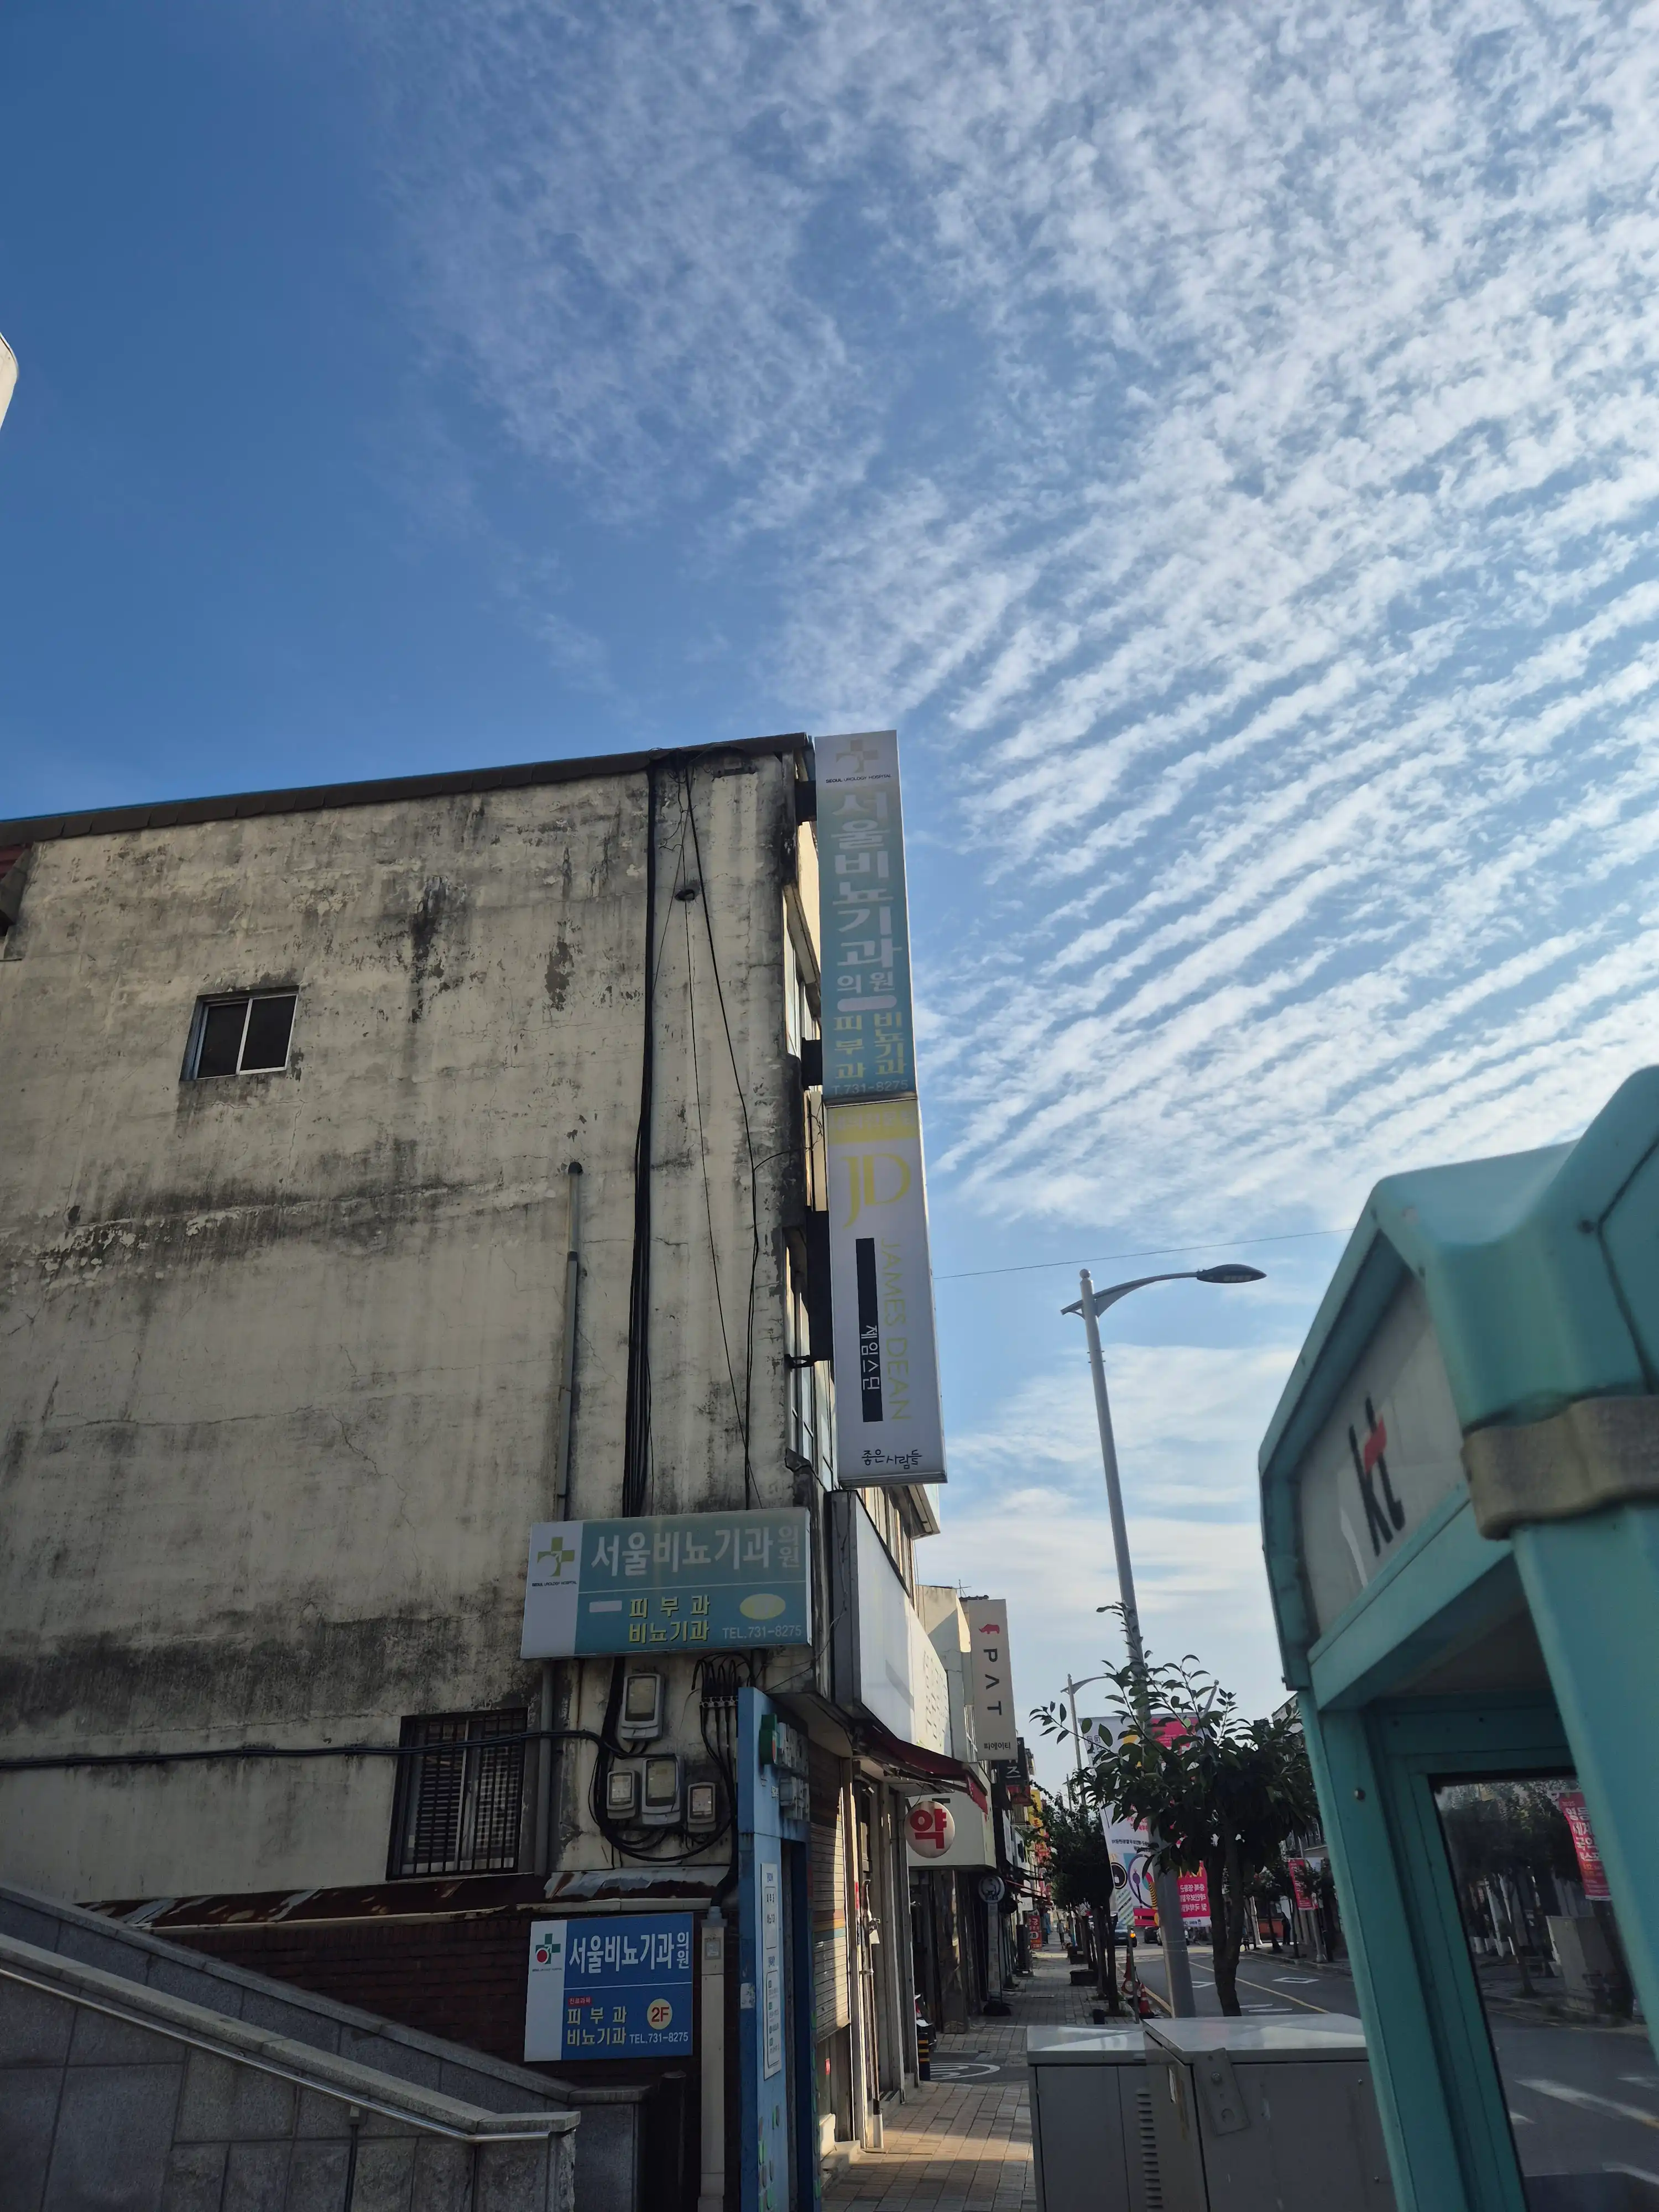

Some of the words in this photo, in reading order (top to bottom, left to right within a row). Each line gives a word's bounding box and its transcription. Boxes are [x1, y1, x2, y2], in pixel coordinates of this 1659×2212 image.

[831, 791, 903, 968] 서울비뇨기과
[873, 1011, 907, 1076] 비뇨기과
[841, 1152, 911, 1228] JD
[880, 1238, 906, 1326] JAMES
[860, 1324, 880, 1391] 제임스딘
[886, 1338, 911, 1422] DEAN
[629, 1620, 711, 1644] 비뇨기과
[722, 1625, 802, 1640] TEL.731-8275
[983, 1741, 1011, 1750] 피에이티
[909, 1808, 947, 1849] 약
[568, 1932, 675, 1974] 서울비뇨기과
[651, 2006, 670, 2022] 2F
[566, 2027, 627, 2047] 비뇨기과
[629, 2031, 688, 2044] TEL.731-8275
